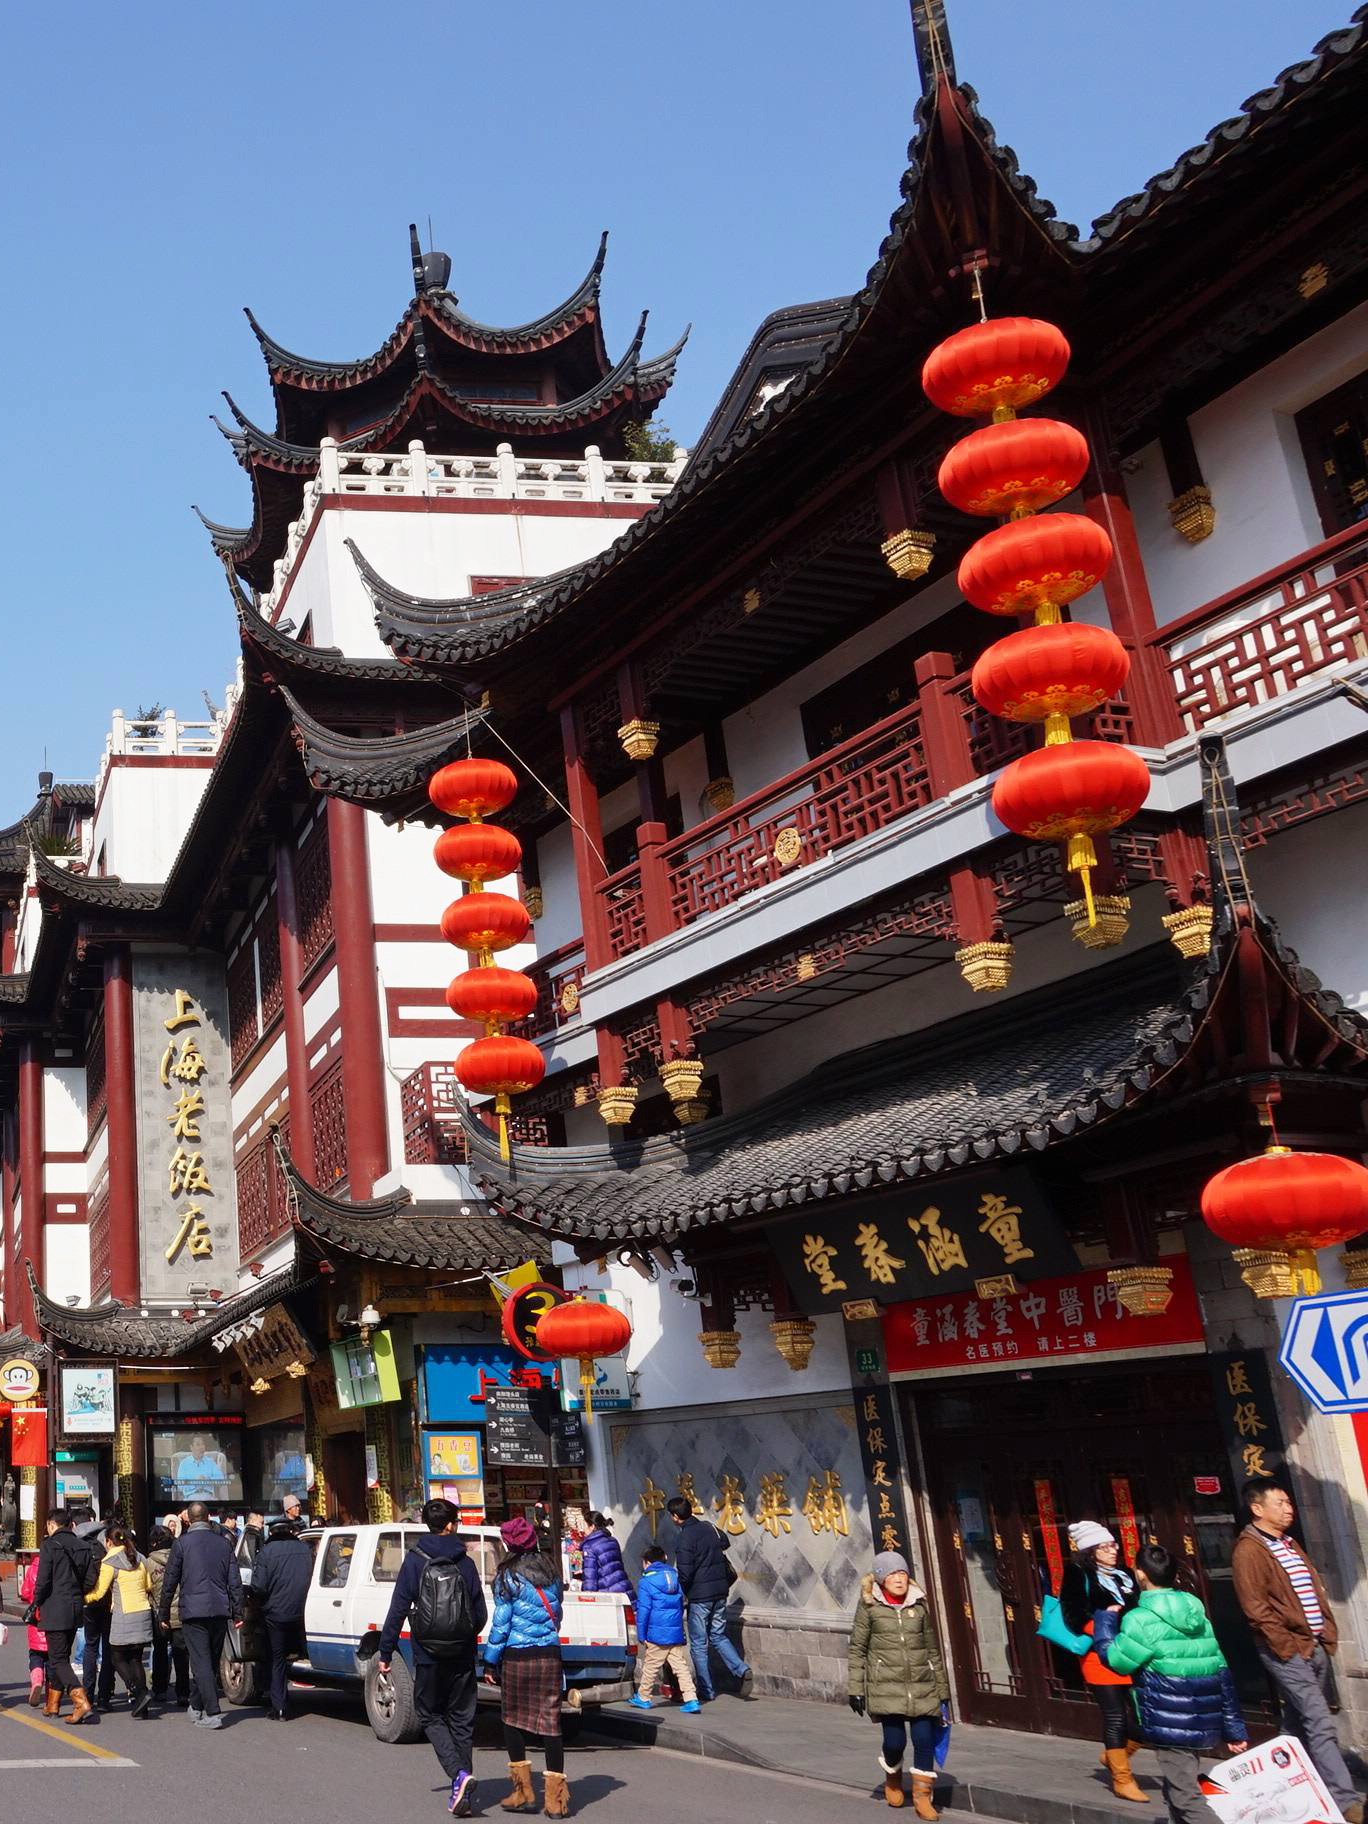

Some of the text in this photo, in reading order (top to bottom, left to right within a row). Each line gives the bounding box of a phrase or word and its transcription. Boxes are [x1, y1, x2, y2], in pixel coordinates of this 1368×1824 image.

[160, 988, 213, 1263] 上海老饭店
[910, 1285, 1124, 1347] 童涵春堂中醫門
[965, 1332, 1098, 1361] 名医预约 请上二楼
